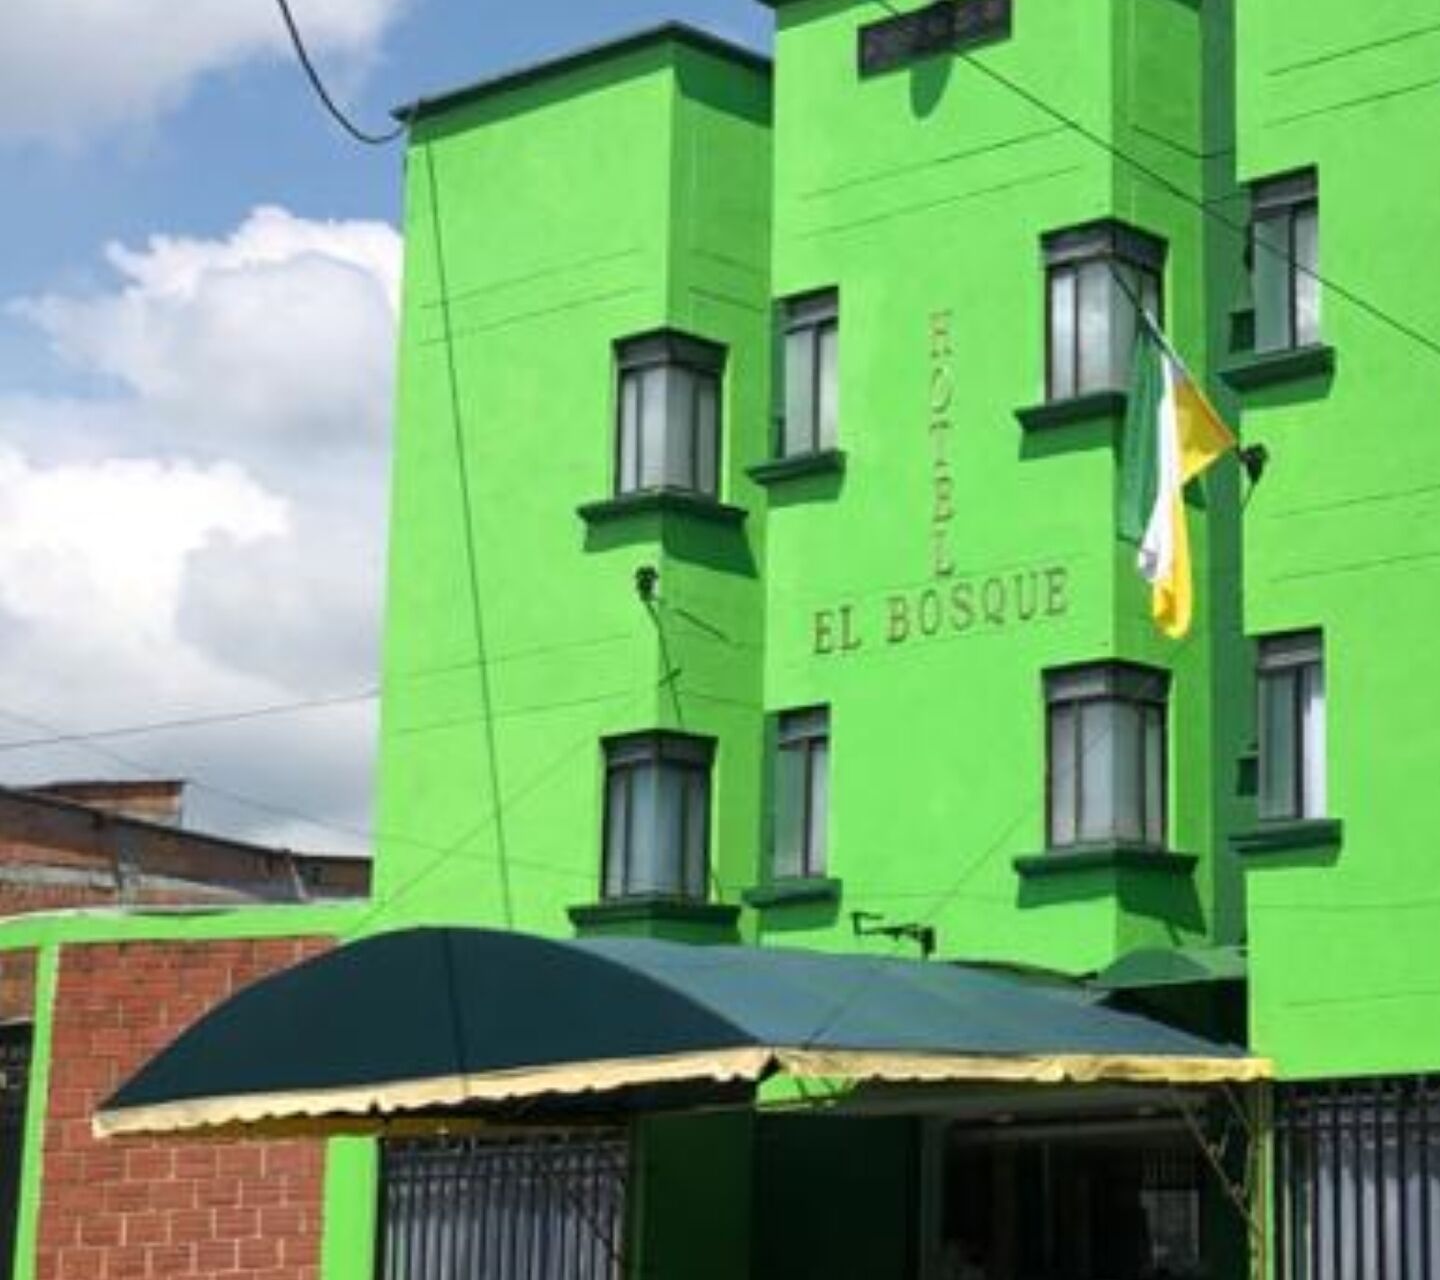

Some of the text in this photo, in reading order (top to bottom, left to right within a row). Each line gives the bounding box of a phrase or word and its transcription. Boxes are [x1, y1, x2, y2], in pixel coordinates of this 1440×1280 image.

[929, 310, 955, 578] HOTEL
[813, 567, 1069, 655] EL BOSQUE
